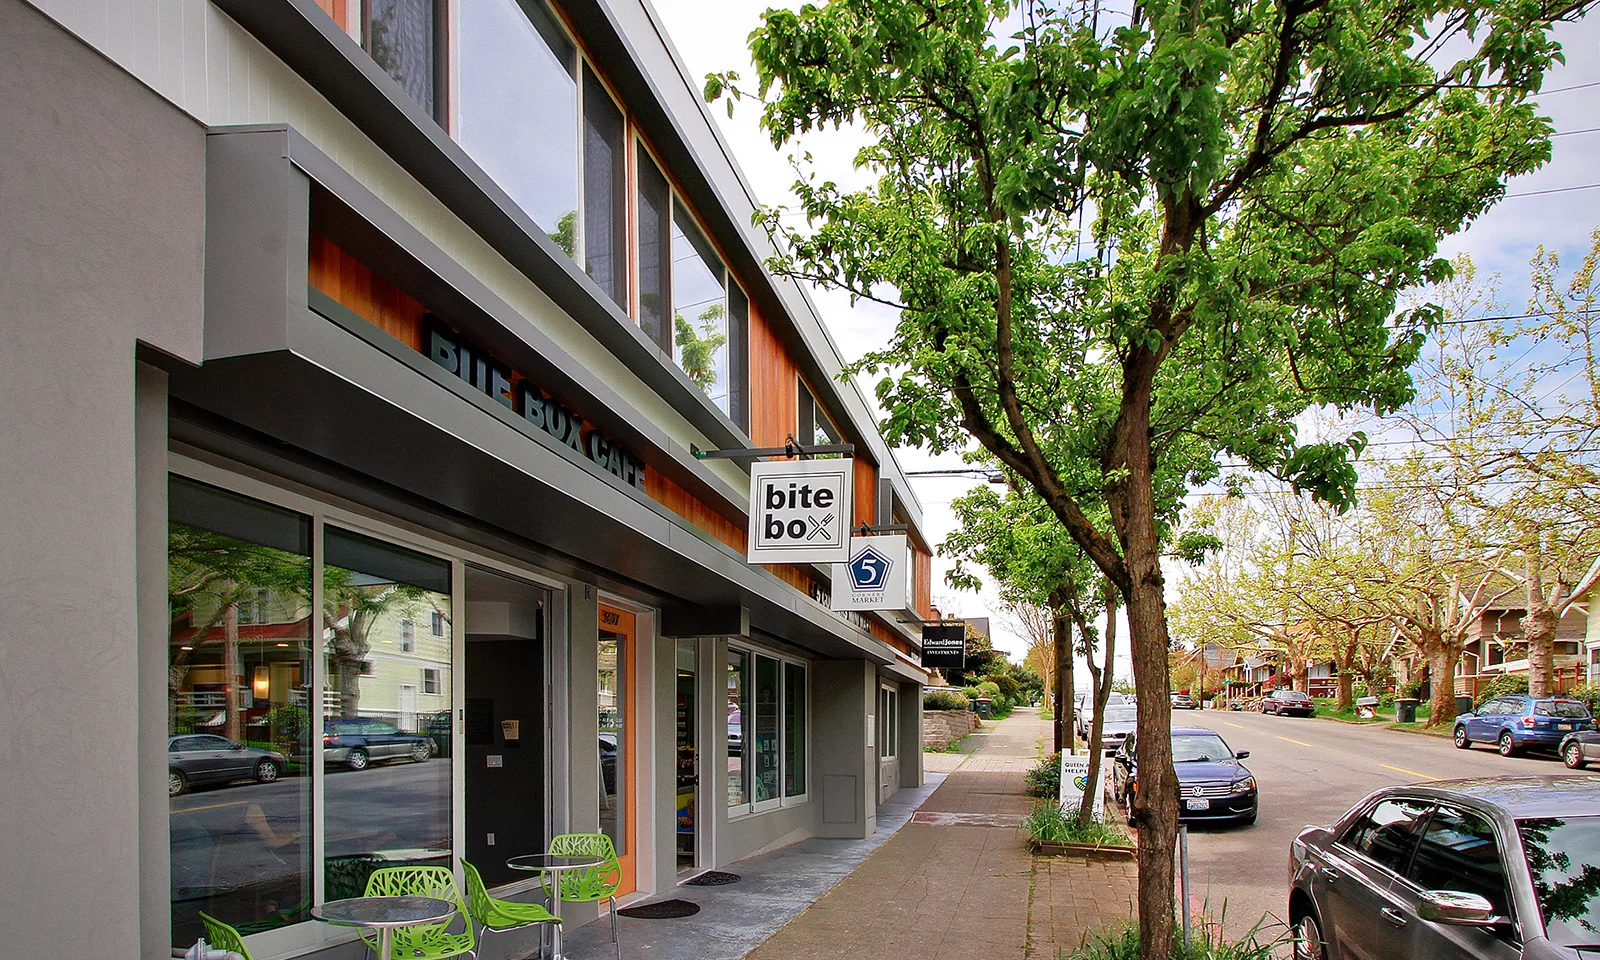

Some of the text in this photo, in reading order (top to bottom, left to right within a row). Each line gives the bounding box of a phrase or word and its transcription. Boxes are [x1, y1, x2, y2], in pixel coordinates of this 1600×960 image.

[517, 378, 586, 456] BOX
[586, 430, 647, 494] CAFE
[766, 483, 834, 510] bite
[859, 559, 877, 584] 5
